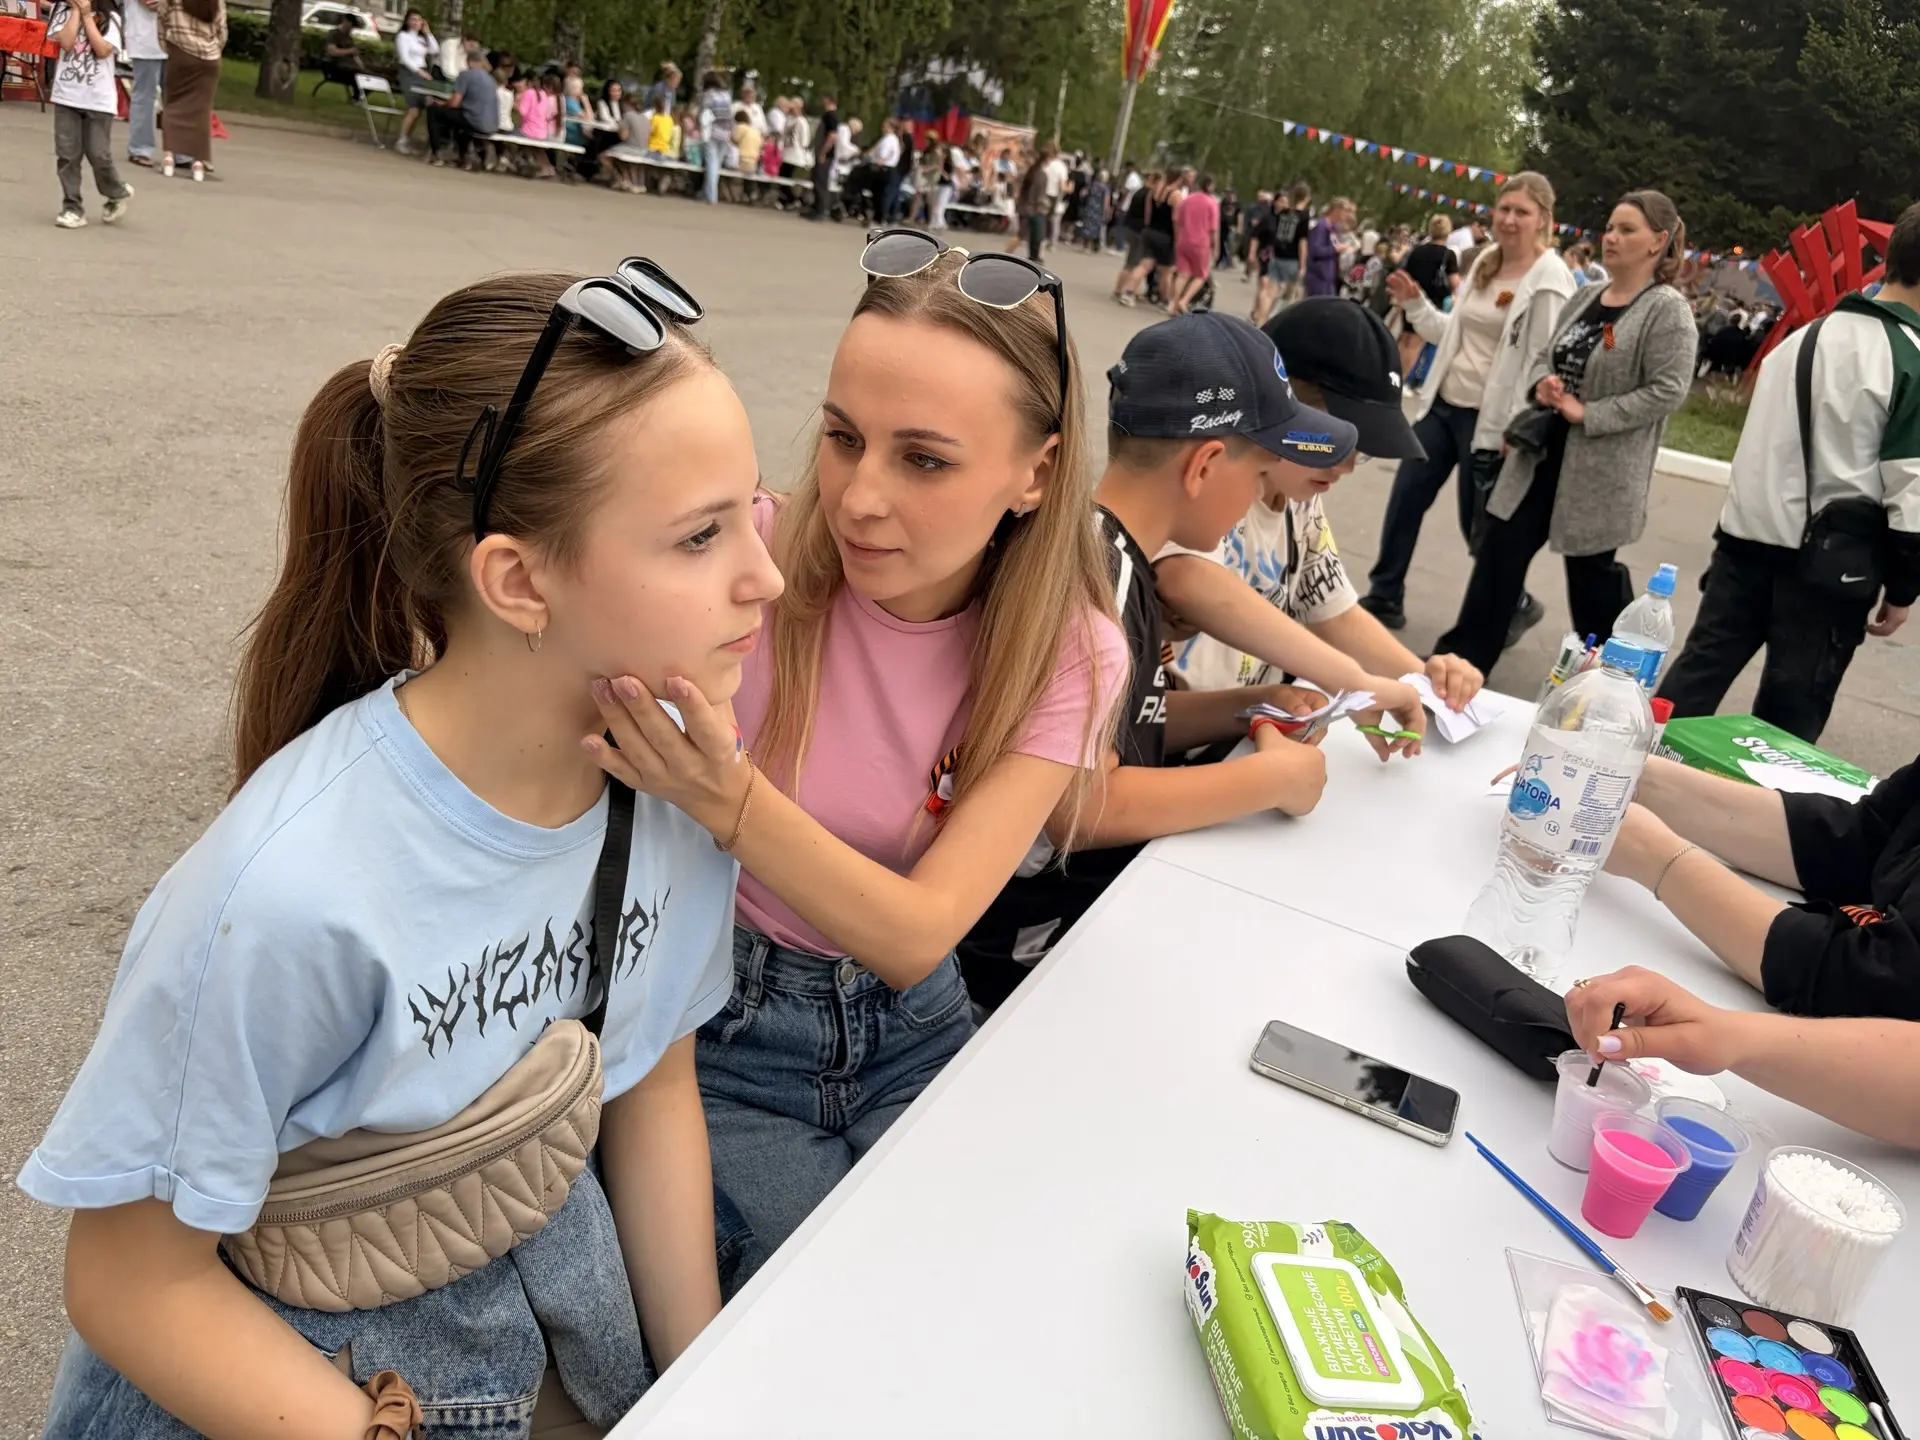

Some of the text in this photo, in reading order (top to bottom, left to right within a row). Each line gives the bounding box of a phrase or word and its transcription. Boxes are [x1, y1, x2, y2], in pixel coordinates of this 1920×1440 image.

[59, 66, 94, 86] LOVE
[1189, 409, 1244, 434] Racing
[1297, 443, 1333, 454] SUBARU
[1301, 1270, 1358, 1374] ГИГИЕНИЧЕСКИЕ
[1336, 1285, 1357, 1309] 100
[1211, 1319, 1244, 1396] ВЛАЖНЫЕ
[1303, 1306, 1343, 1373] ВЛАЖНЫЕ
[1332, 1308, 1373, 1376] САЛФЕТКИ
[1207, 1332, 1262, 1440] ГИГИЕНИЧЕСКИ
